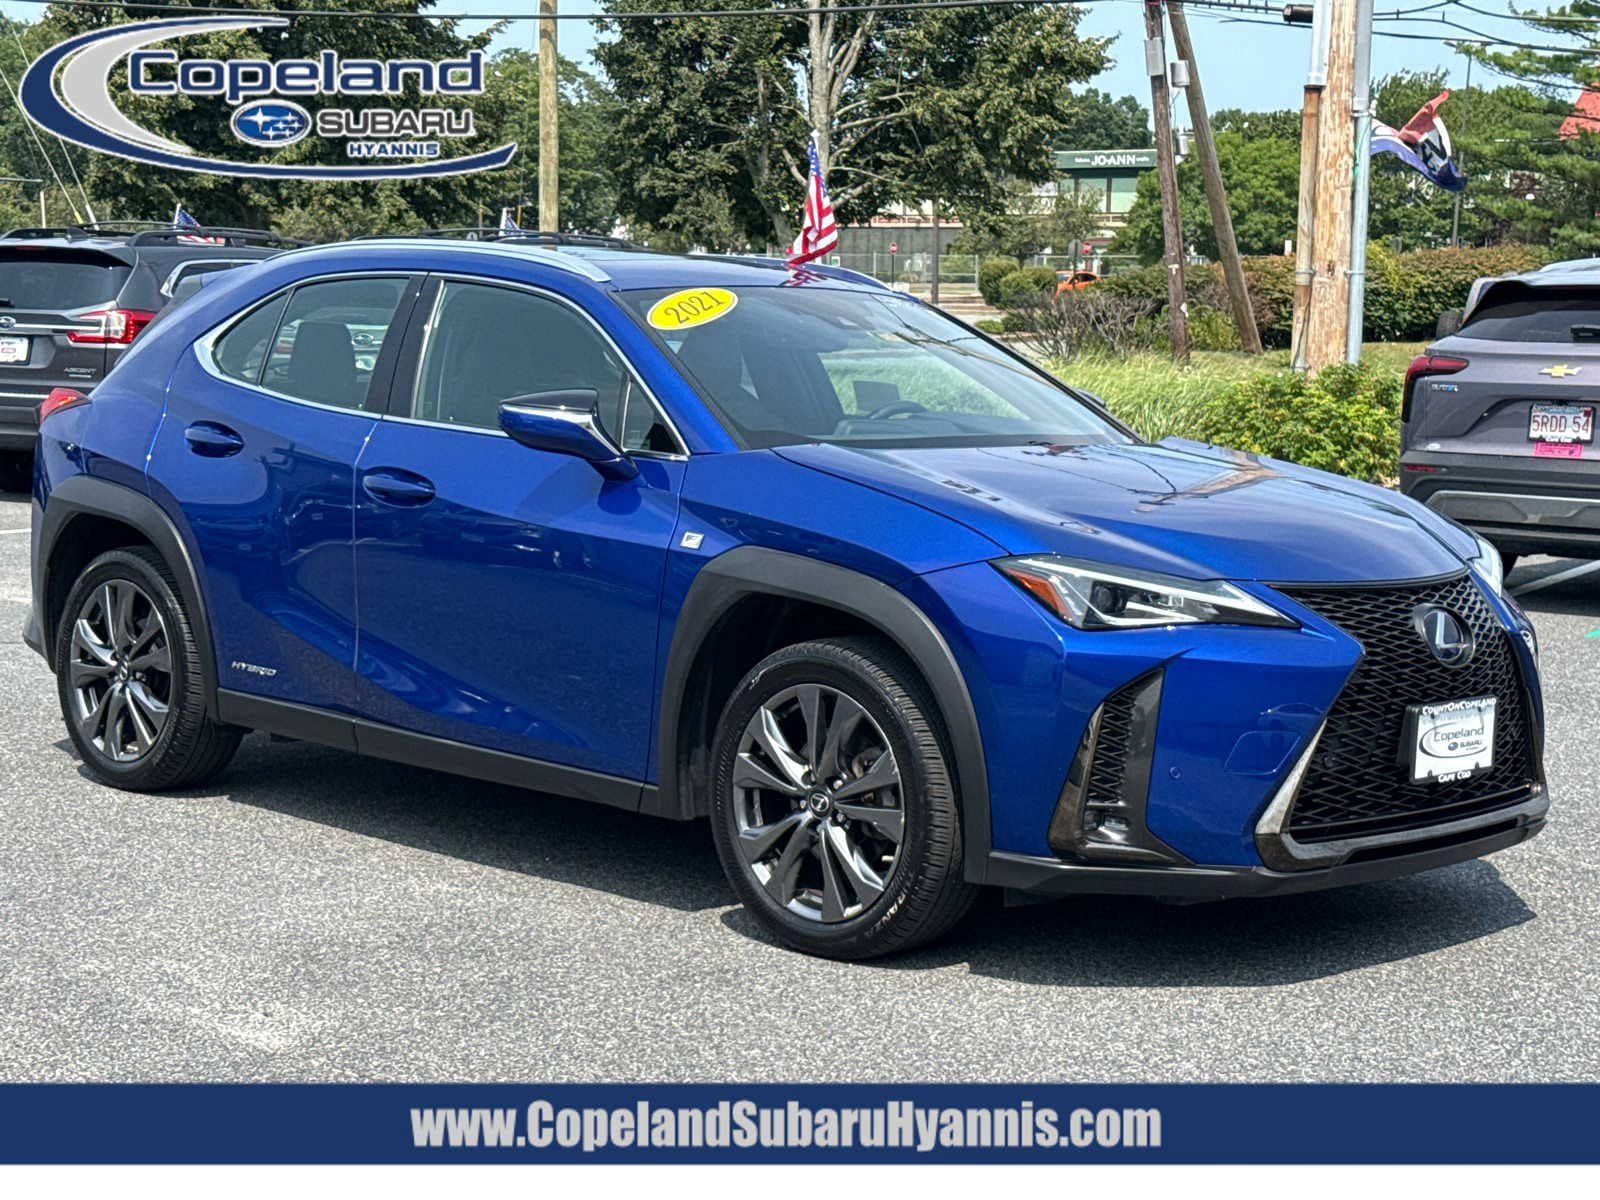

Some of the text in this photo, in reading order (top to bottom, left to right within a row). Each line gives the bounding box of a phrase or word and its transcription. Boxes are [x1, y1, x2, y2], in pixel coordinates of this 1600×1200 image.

[664, 291, 726, 324] 2021
[1532, 414, 1590, 433] 5RDD 54
[231, 661, 277, 676] HYBRID
[1433, 727, 1485, 743] Copeland
